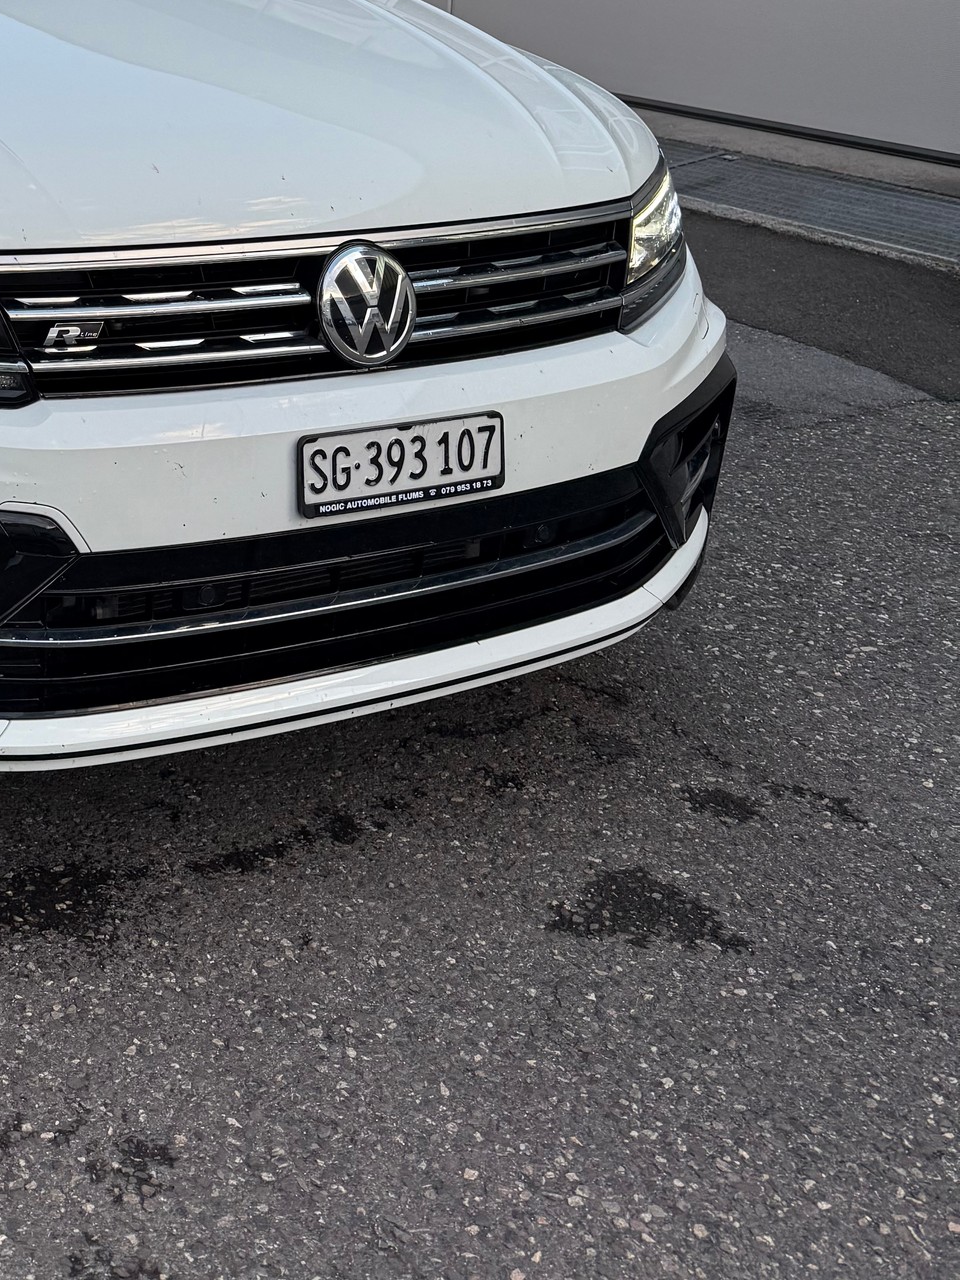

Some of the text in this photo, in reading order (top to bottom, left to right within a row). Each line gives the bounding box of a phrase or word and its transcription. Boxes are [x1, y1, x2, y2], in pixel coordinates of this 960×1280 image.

[319, 479, 492, 513] NOGIC AUTOMOBILE FLUMS 079 953 18 73
